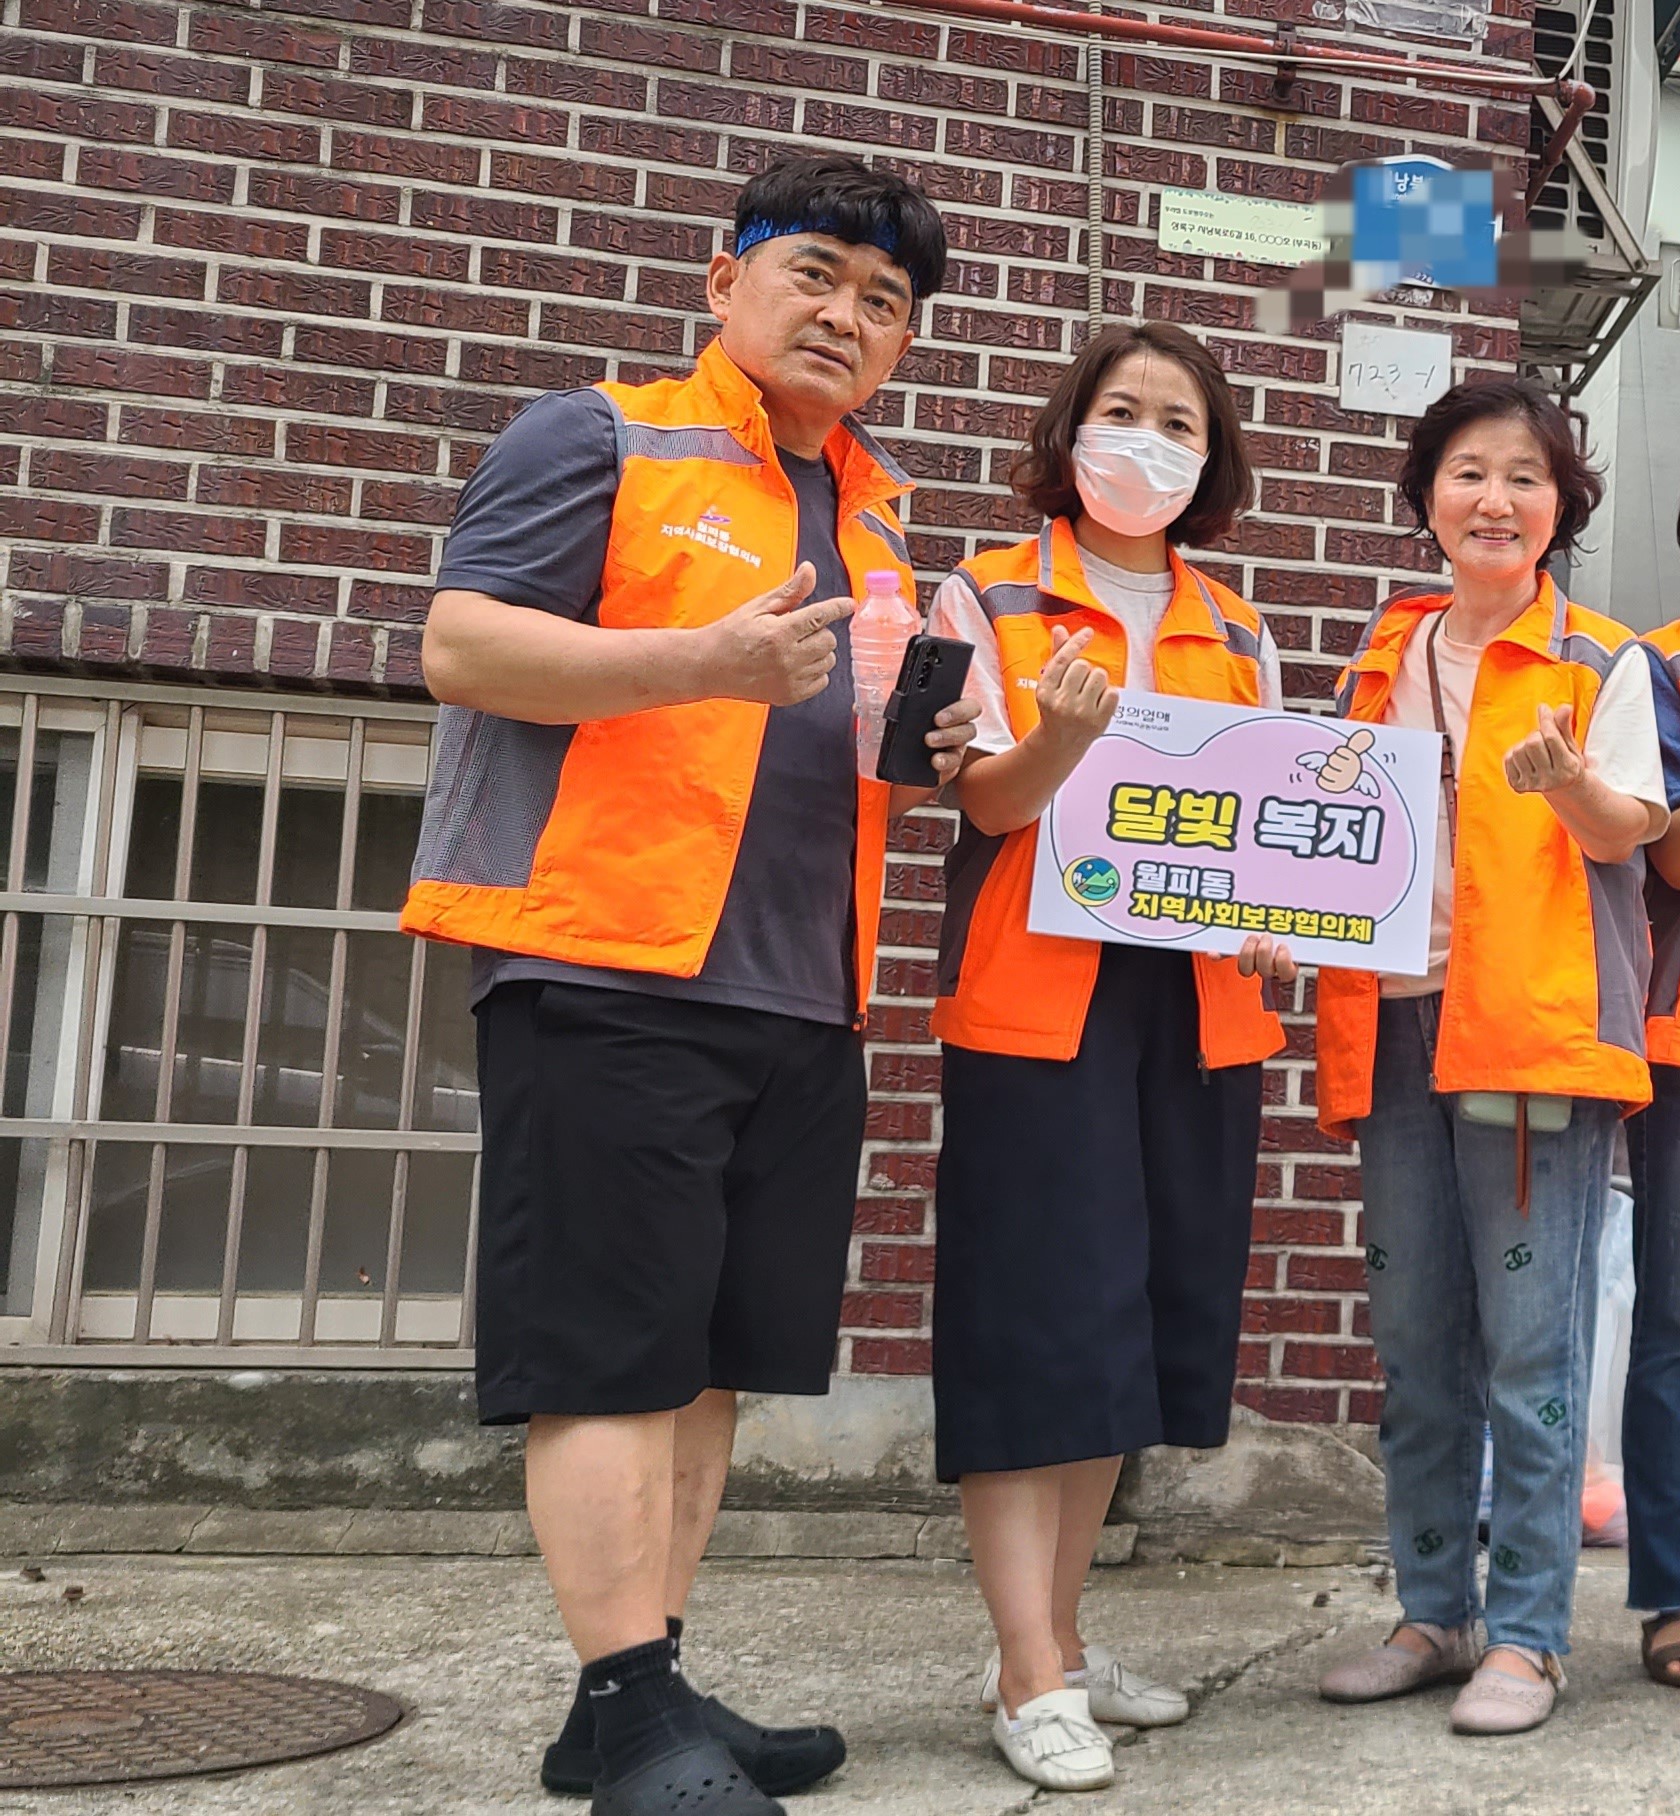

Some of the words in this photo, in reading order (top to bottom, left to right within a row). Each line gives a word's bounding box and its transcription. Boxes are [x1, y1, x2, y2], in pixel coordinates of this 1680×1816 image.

[1107, 782, 1241, 851] 달빛
[1255, 796, 1386, 864] 복지
[1131, 860, 1236, 901] 월피동
[1128, 892, 1376, 944] 지역사회보장협의체
